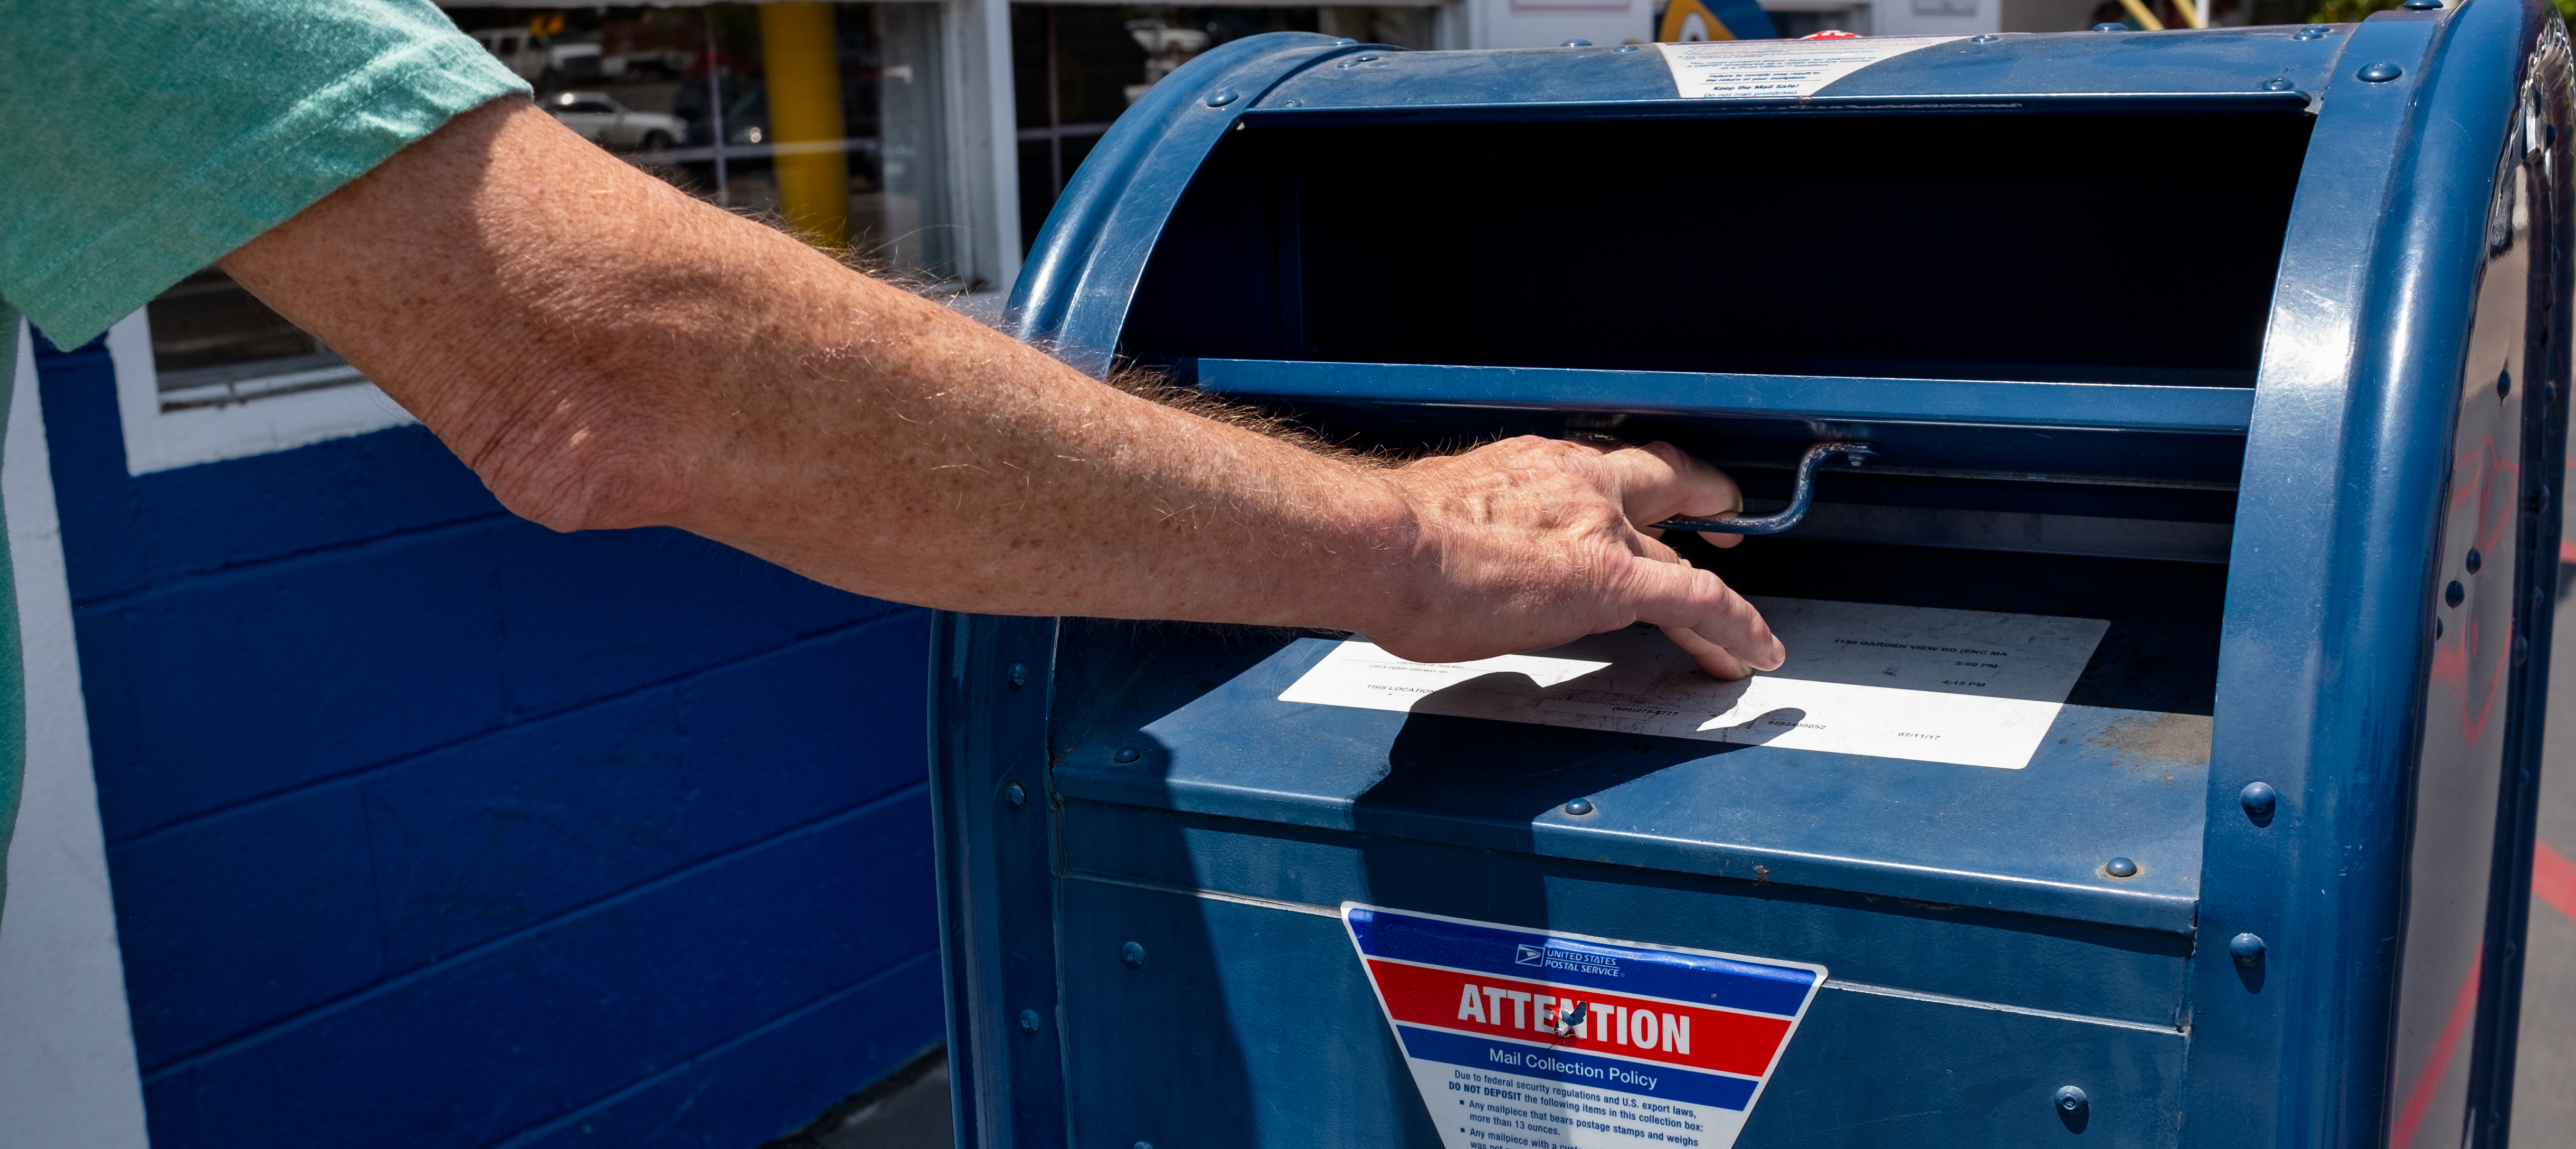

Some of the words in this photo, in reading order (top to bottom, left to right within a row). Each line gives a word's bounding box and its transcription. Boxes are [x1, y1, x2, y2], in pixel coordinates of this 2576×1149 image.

[1860, 641, 1908, 649] GARDEN
[1767, 720, 1826, 730] 9202400052
[1545, 959, 1579, 972] POSTAL
[1547, 949, 1583, 960] UNITED
[1584, 955, 1616, 966] STATES
[1490, 1048, 1521, 1066] Mail
[1526, 1054, 1604, 1079] Collection
[1609, 1067, 1658, 1090] Policy
[1455, 1070, 1471, 1080] Due
[1473, 1073, 1481, 1082] to
[1484, 1075, 1513, 1087] federal
[1516, 1081, 1550, 1095] security
[1552, 1086, 1600, 1102] regulations
[1604, 1096, 1620, 1105] and
[1623, 1097, 1639, 1108] U.S.
[1642, 1102, 1670, 1113] export
[1673, 1105, 1696, 1119] laws,
[1449, 1082, 1461, 1091] DO
[1464, 1084, 1481, 1094] NOT
[1484, 1087, 1521, 1101] DEPOSIT
[1524, 1094, 1538, 1104] the
[1540, 1096, 1579, 1113] following
[1583, 1104, 1606, 1116] items
[1609, 1108, 1616, 1117] in
[1620, 1110, 1636, 1120] this
[1639, 1115, 1681, 1128] collection
[1684, 1120, 1703, 1132] box:
[1469, 1100, 1484, 1112] Any
[1487, 1103, 1528, 1117] mailpiece
[1530, 1110, 1547, 1121] that
[1550, 1113, 1574, 1126] bears
[1576, 1118, 1611, 1133] postage
[1613, 1125, 1645, 1138] stamps
[1647, 1130, 1664, 1141] and
[1667, 1134, 1698, 1147] weighs
[1470, 1113, 1491, 1124] more
[1493, 1116, 1512, 1127] than
[1515, 1120, 1525, 1129] 13
[1528, 1123, 1561, 1136] ounces.
[1470, 1127, 1485, 1139] Any
[1488, 1132, 1528, 1146] mailpiece
[1531, 1138, 1549, 1149] with
